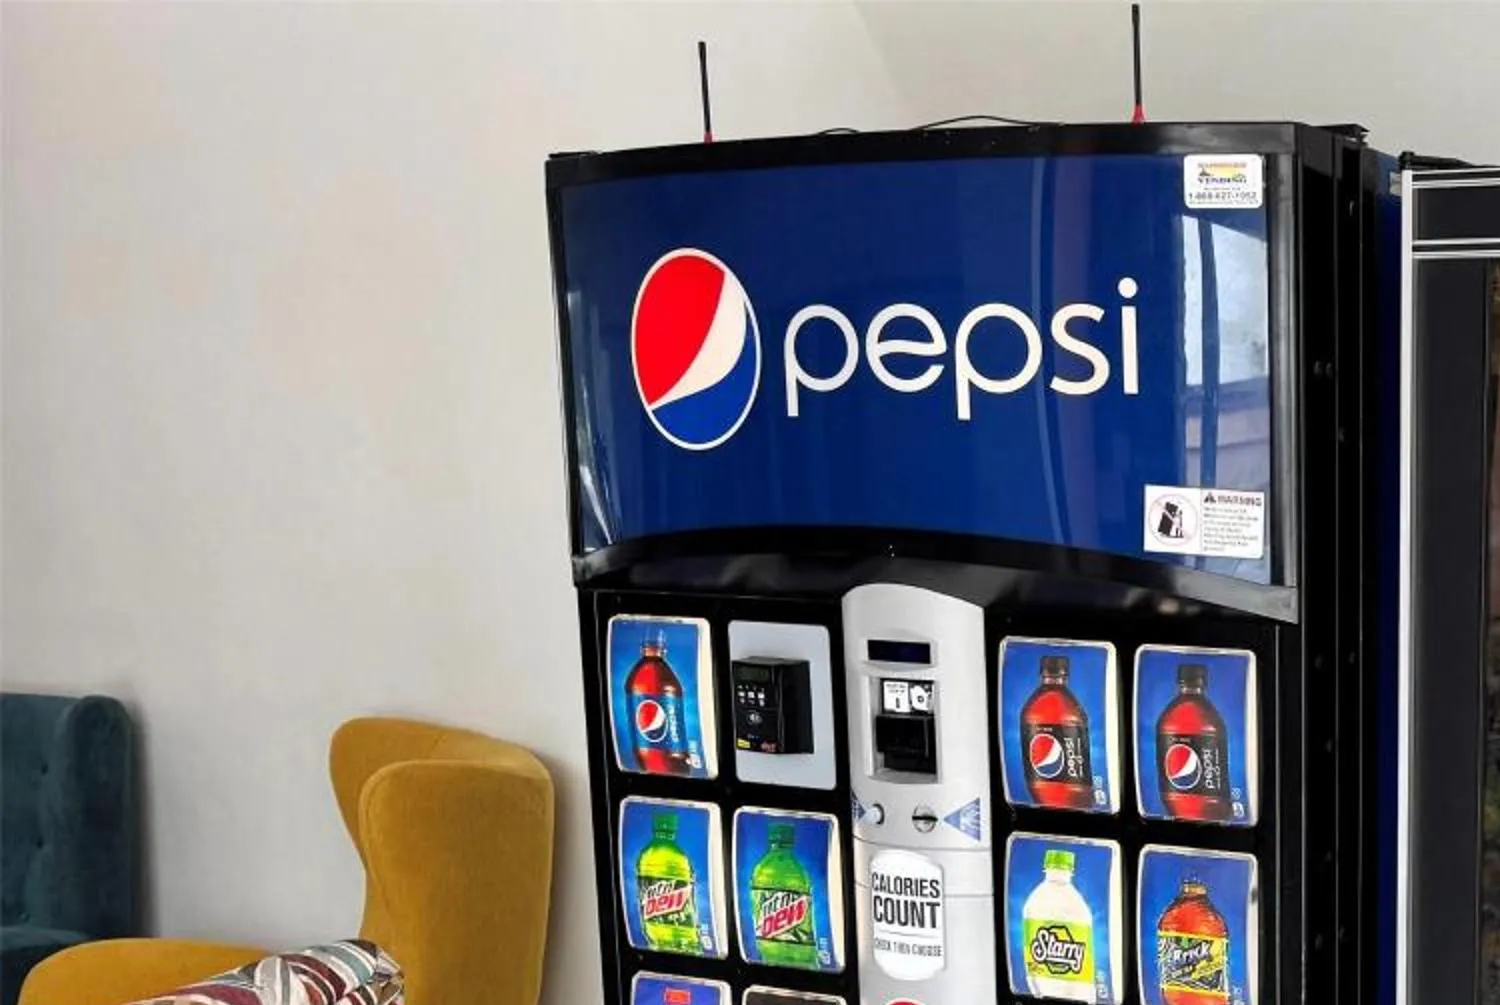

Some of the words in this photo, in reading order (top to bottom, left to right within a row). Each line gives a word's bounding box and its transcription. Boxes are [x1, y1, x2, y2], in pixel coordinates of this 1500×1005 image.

[784, 276, 1139, 421] pepsi
[1063, 737, 1078, 778] pepsi
[1203, 747, 1217, 790] pepsi
[872, 871, 941, 899] CALORIES
[873, 895, 941, 929] COUNT
[1032, 928, 1087, 971] Starry
